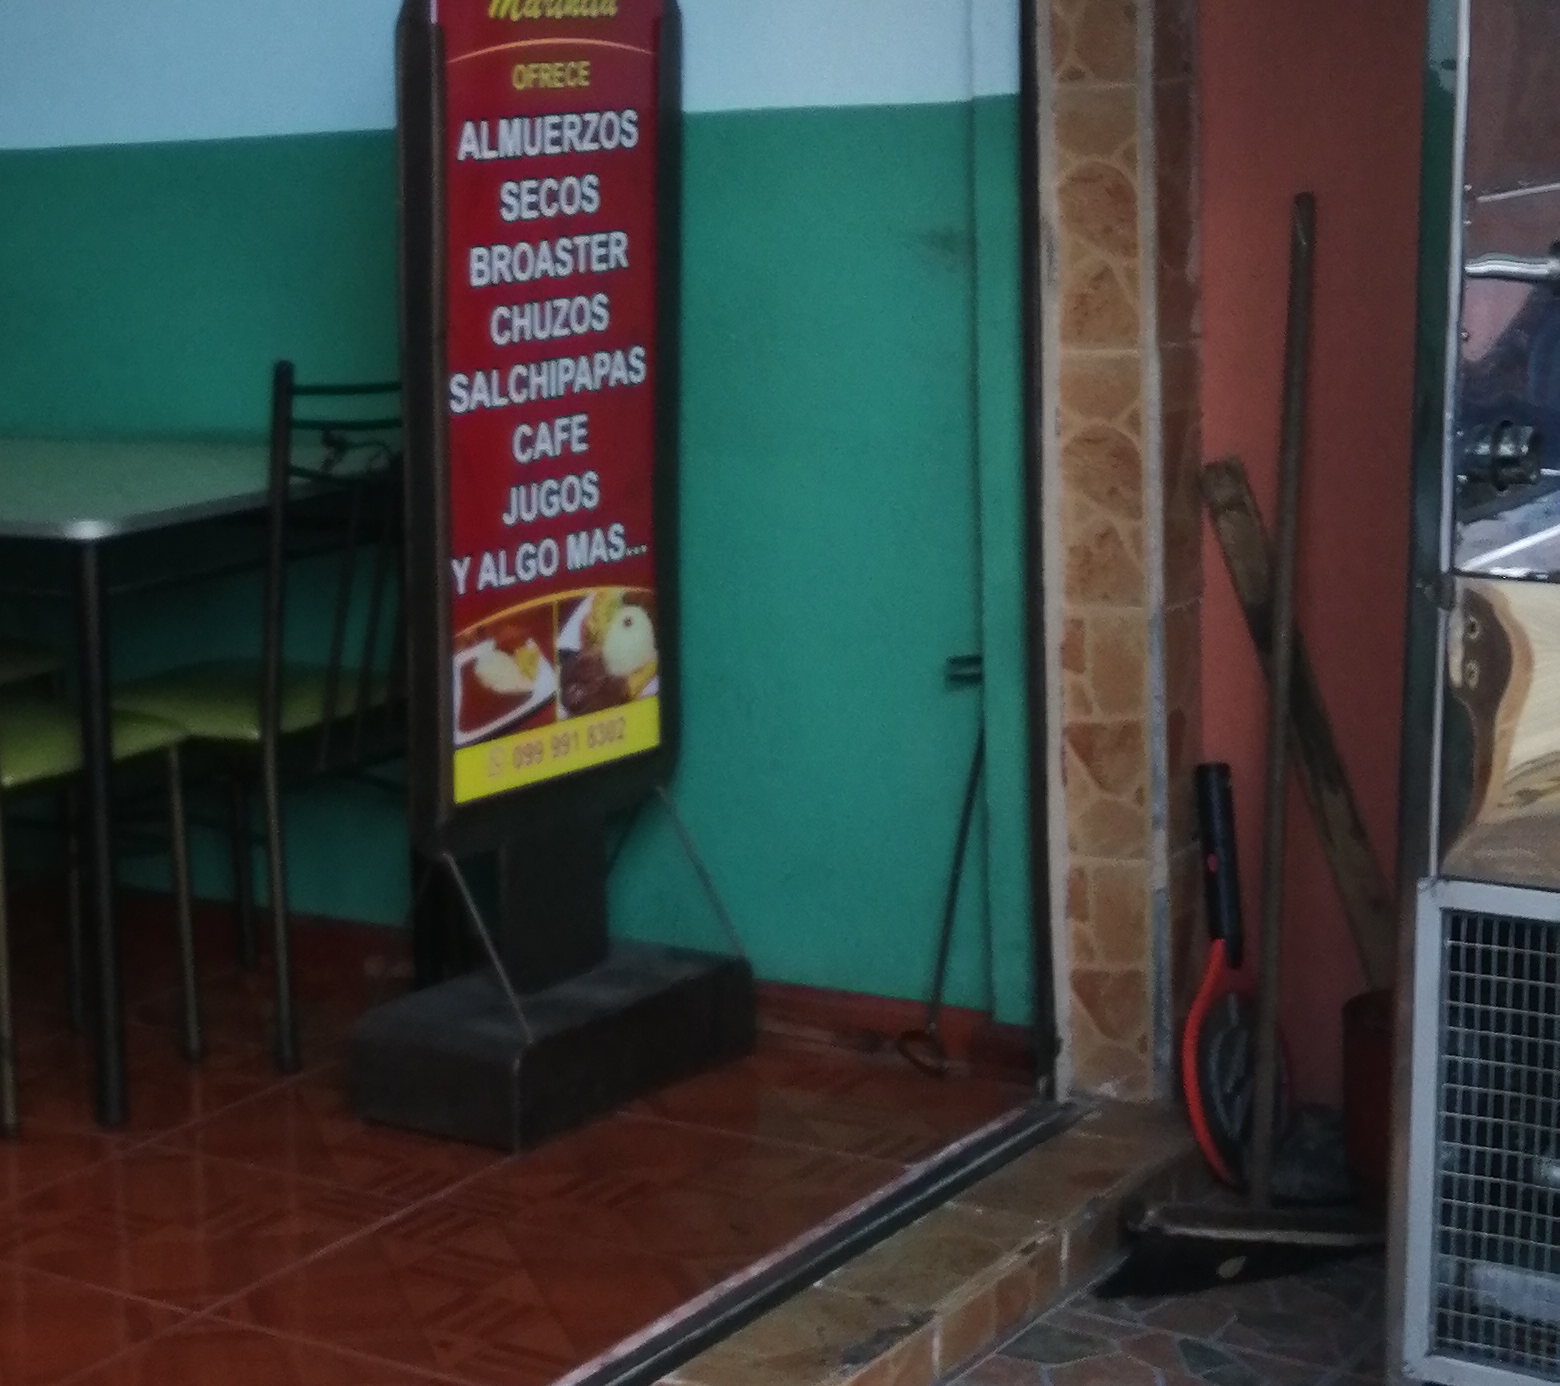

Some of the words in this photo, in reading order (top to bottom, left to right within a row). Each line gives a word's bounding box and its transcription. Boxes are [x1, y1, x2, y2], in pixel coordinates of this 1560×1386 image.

[512, 60, 591, 91] OFRECE
[456, 108, 640, 162] ALMUERZOS
[498, 173, 601, 223] SECOS
[468, 229, 630, 288] BROASTER
[489, 292, 610, 346] CHUZOS
[448, 345, 648, 415] SALCHIPAPAS
[510, 413, 590, 465] CAFE
[501, 470, 600, 528] JUGOS
[450, 556, 471, 596] Y
[476, 544, 557, 594] ALGO
